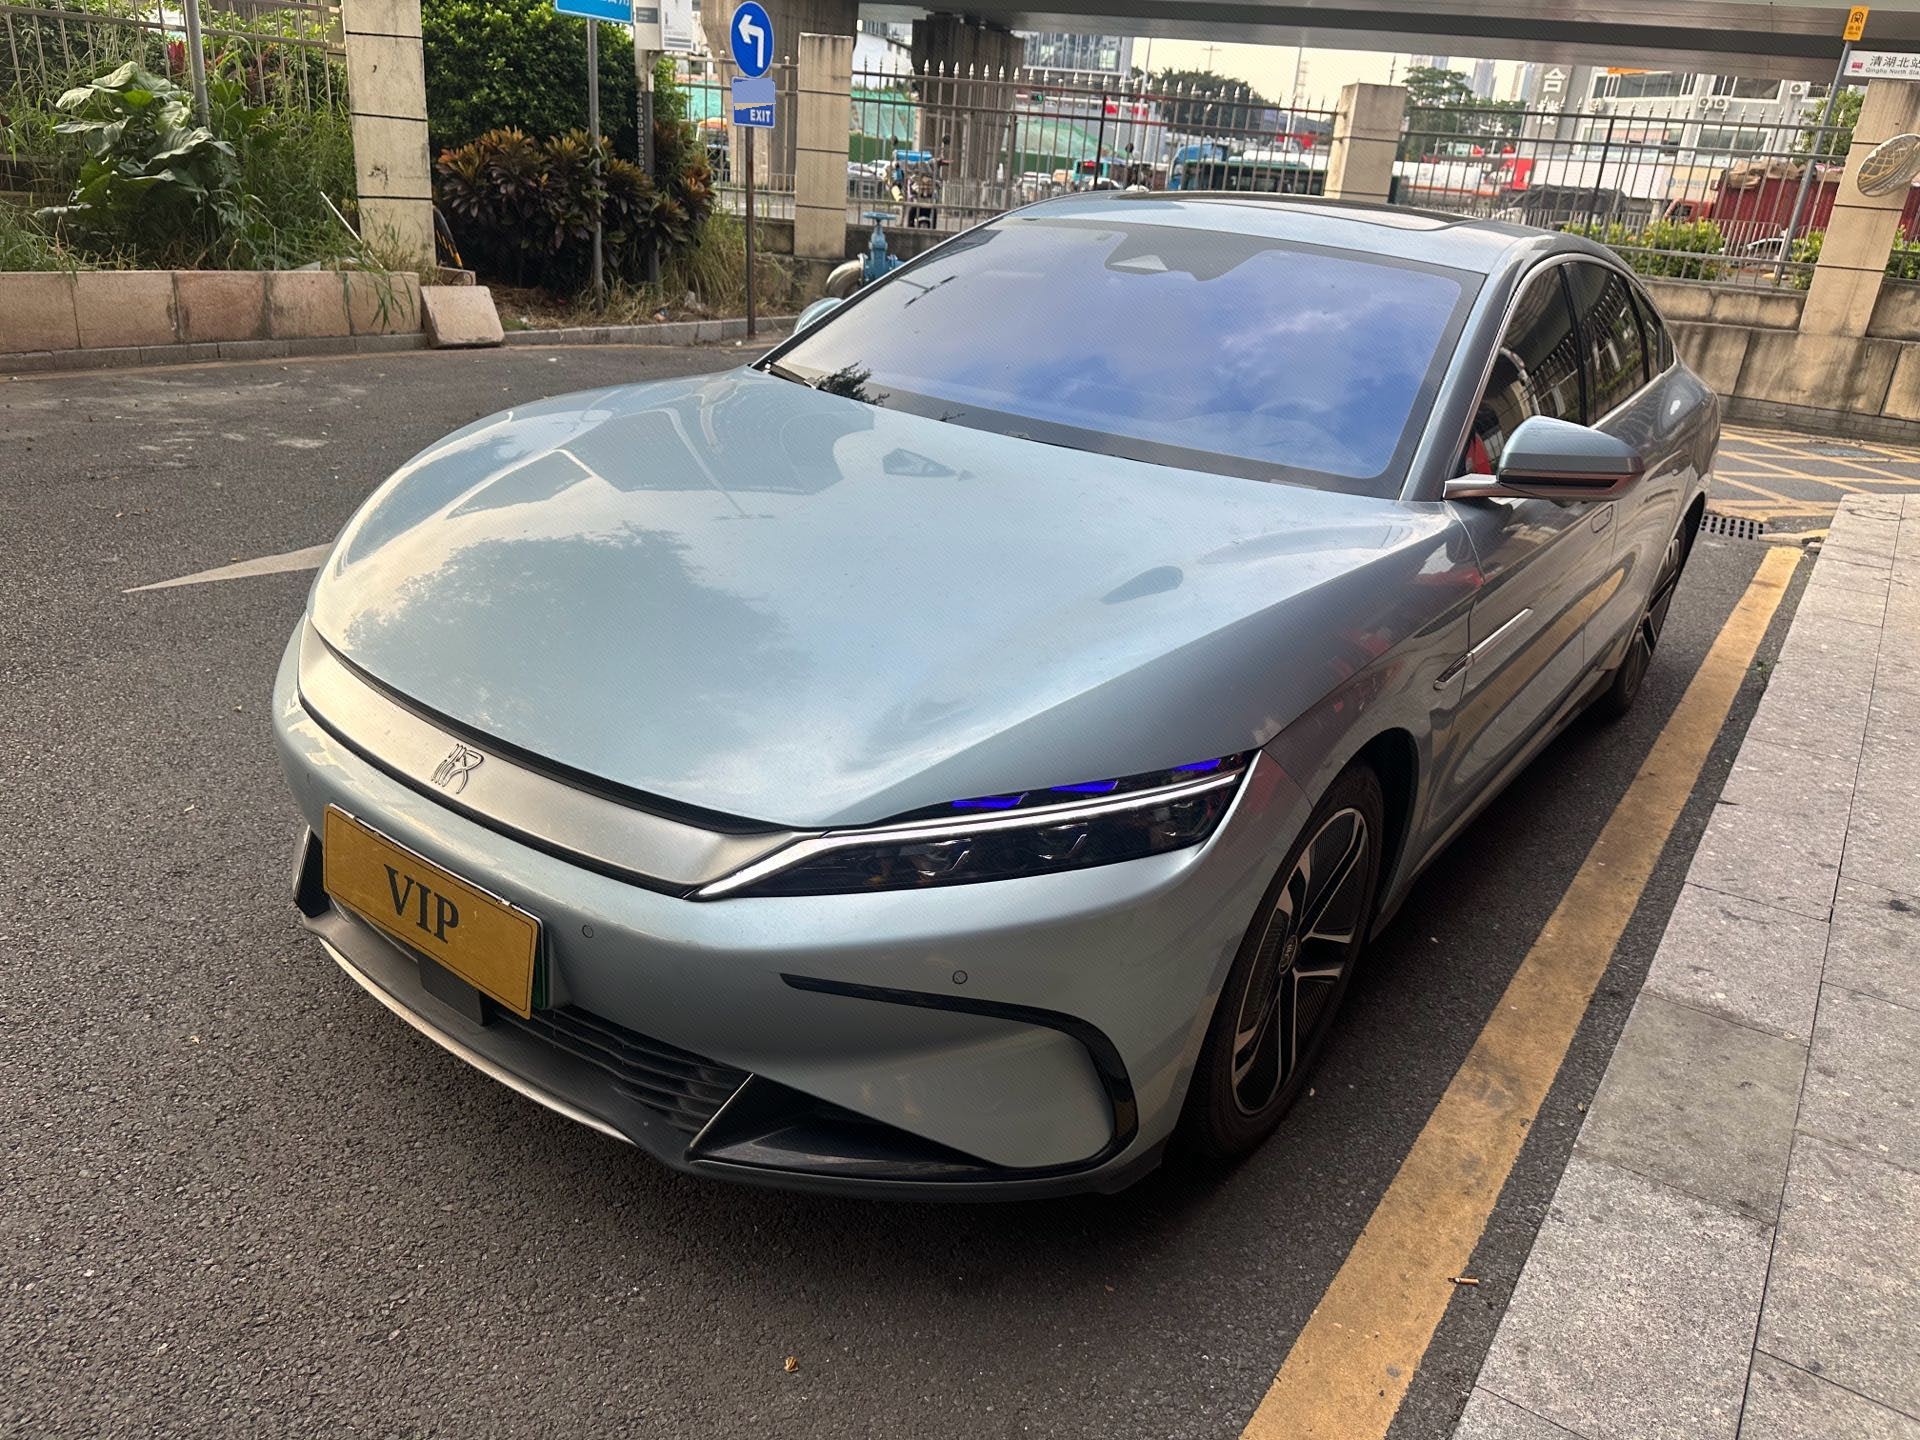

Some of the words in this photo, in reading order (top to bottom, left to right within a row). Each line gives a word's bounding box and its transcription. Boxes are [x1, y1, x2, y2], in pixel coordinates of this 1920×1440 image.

[1869, 55, 1920, 69] 清湖北站
[750, 109, 771, 122] EXIT
[383, 863, 459, 944] VIP
